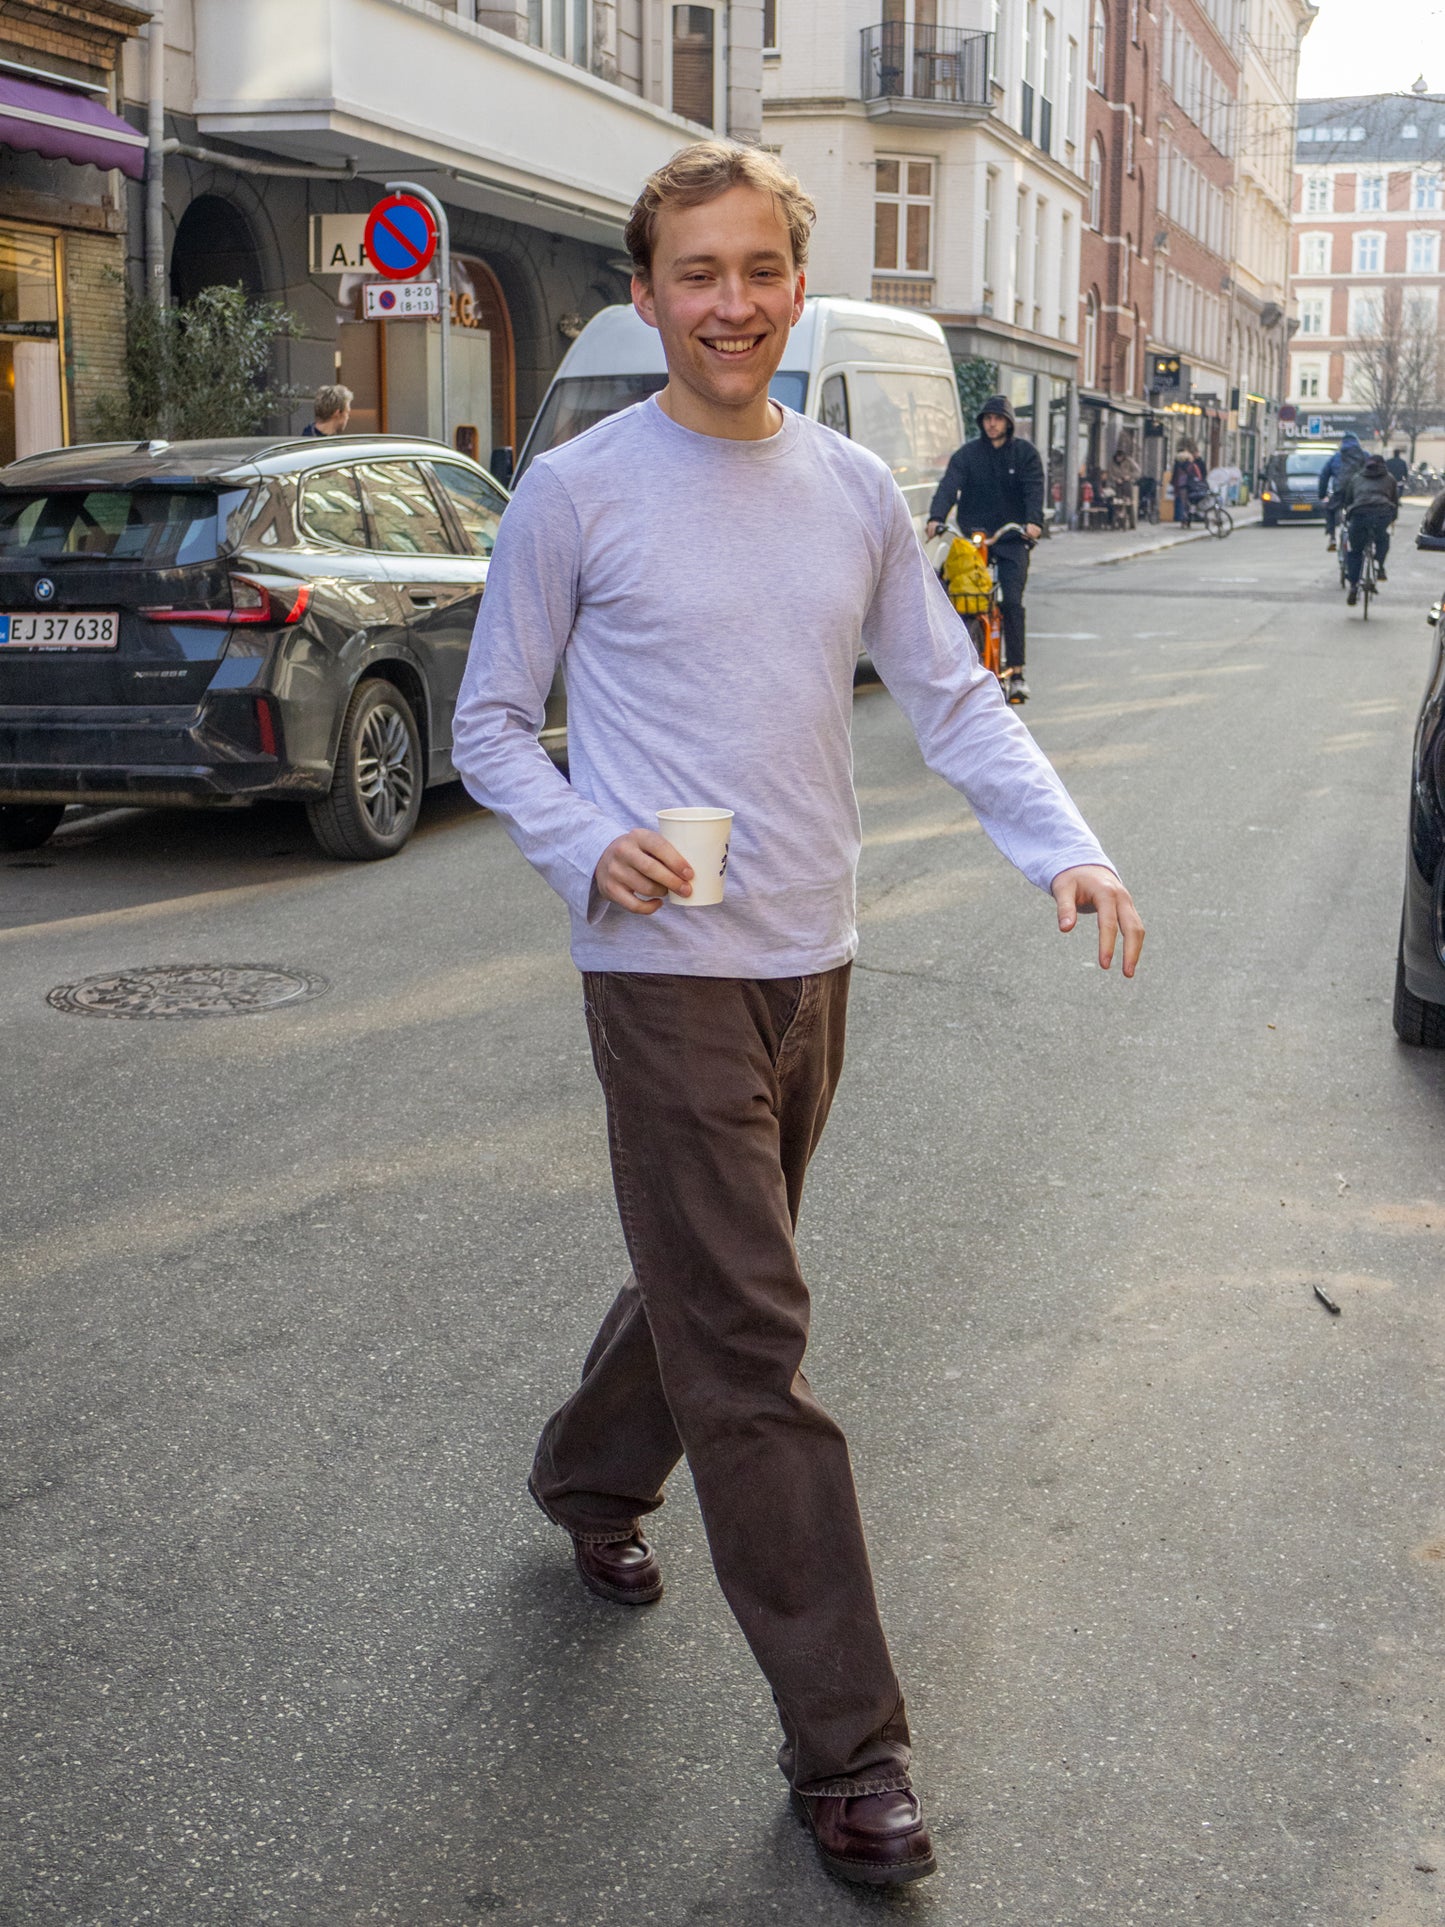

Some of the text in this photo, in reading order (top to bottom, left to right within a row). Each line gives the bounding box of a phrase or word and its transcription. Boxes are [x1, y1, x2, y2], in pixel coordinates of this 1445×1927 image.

[404, 286, 432, 297] 8-20
[400, 300, 434, 312] (8-13)
[11, 618, 113, 641] EJ 37 638
